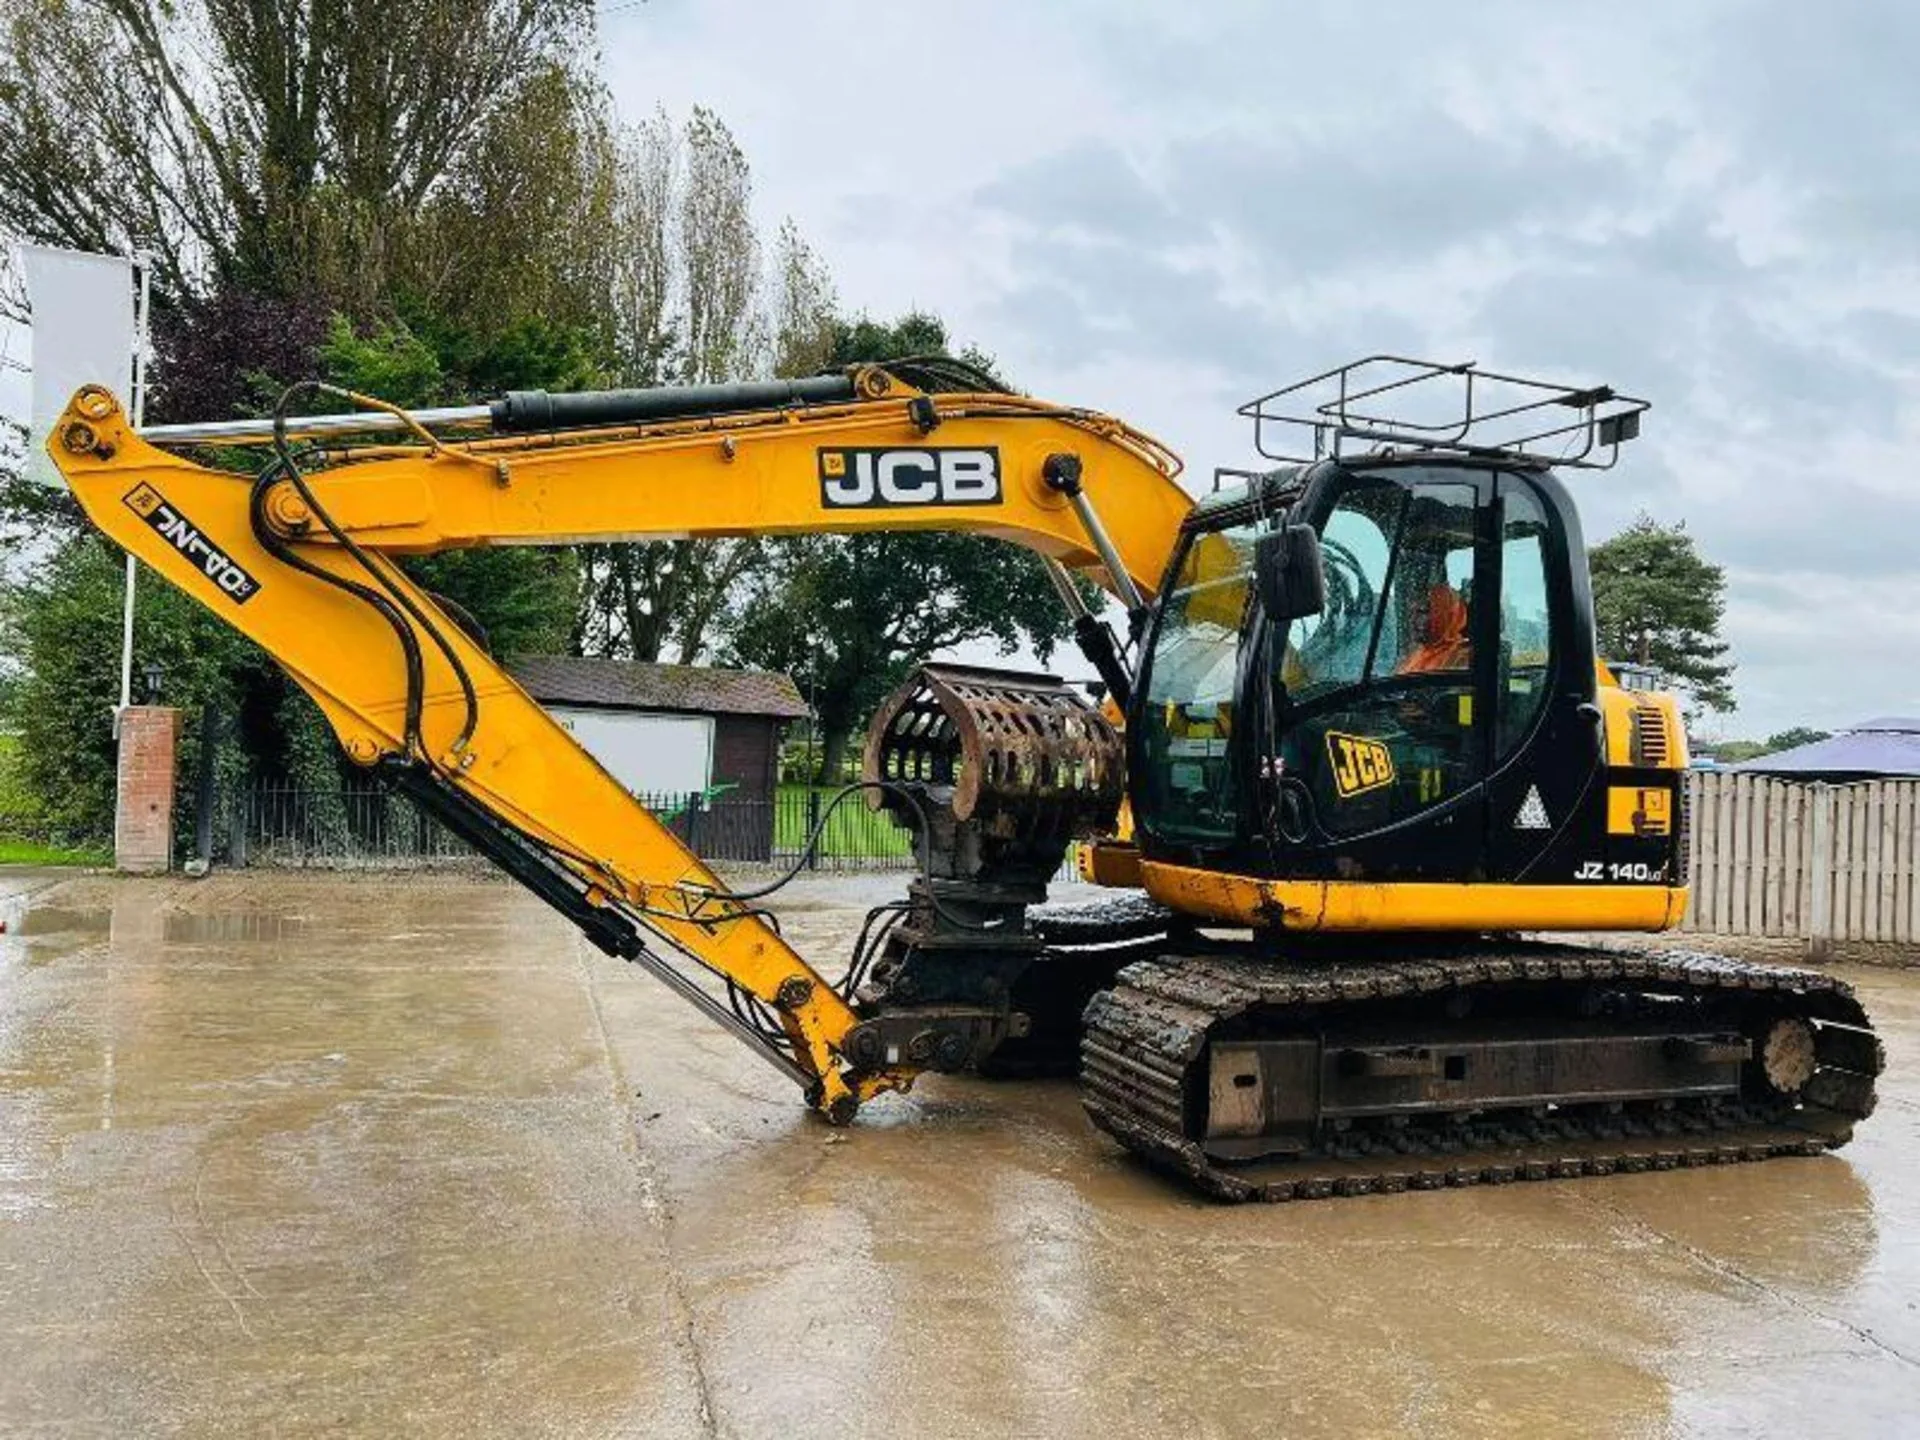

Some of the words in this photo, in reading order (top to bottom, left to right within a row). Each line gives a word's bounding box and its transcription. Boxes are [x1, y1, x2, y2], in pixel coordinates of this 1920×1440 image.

[825, 451, 998, 504] JCB
[1338, 737, 1390, 791] JCB
[1573, 861, 1604, 880] JZ
